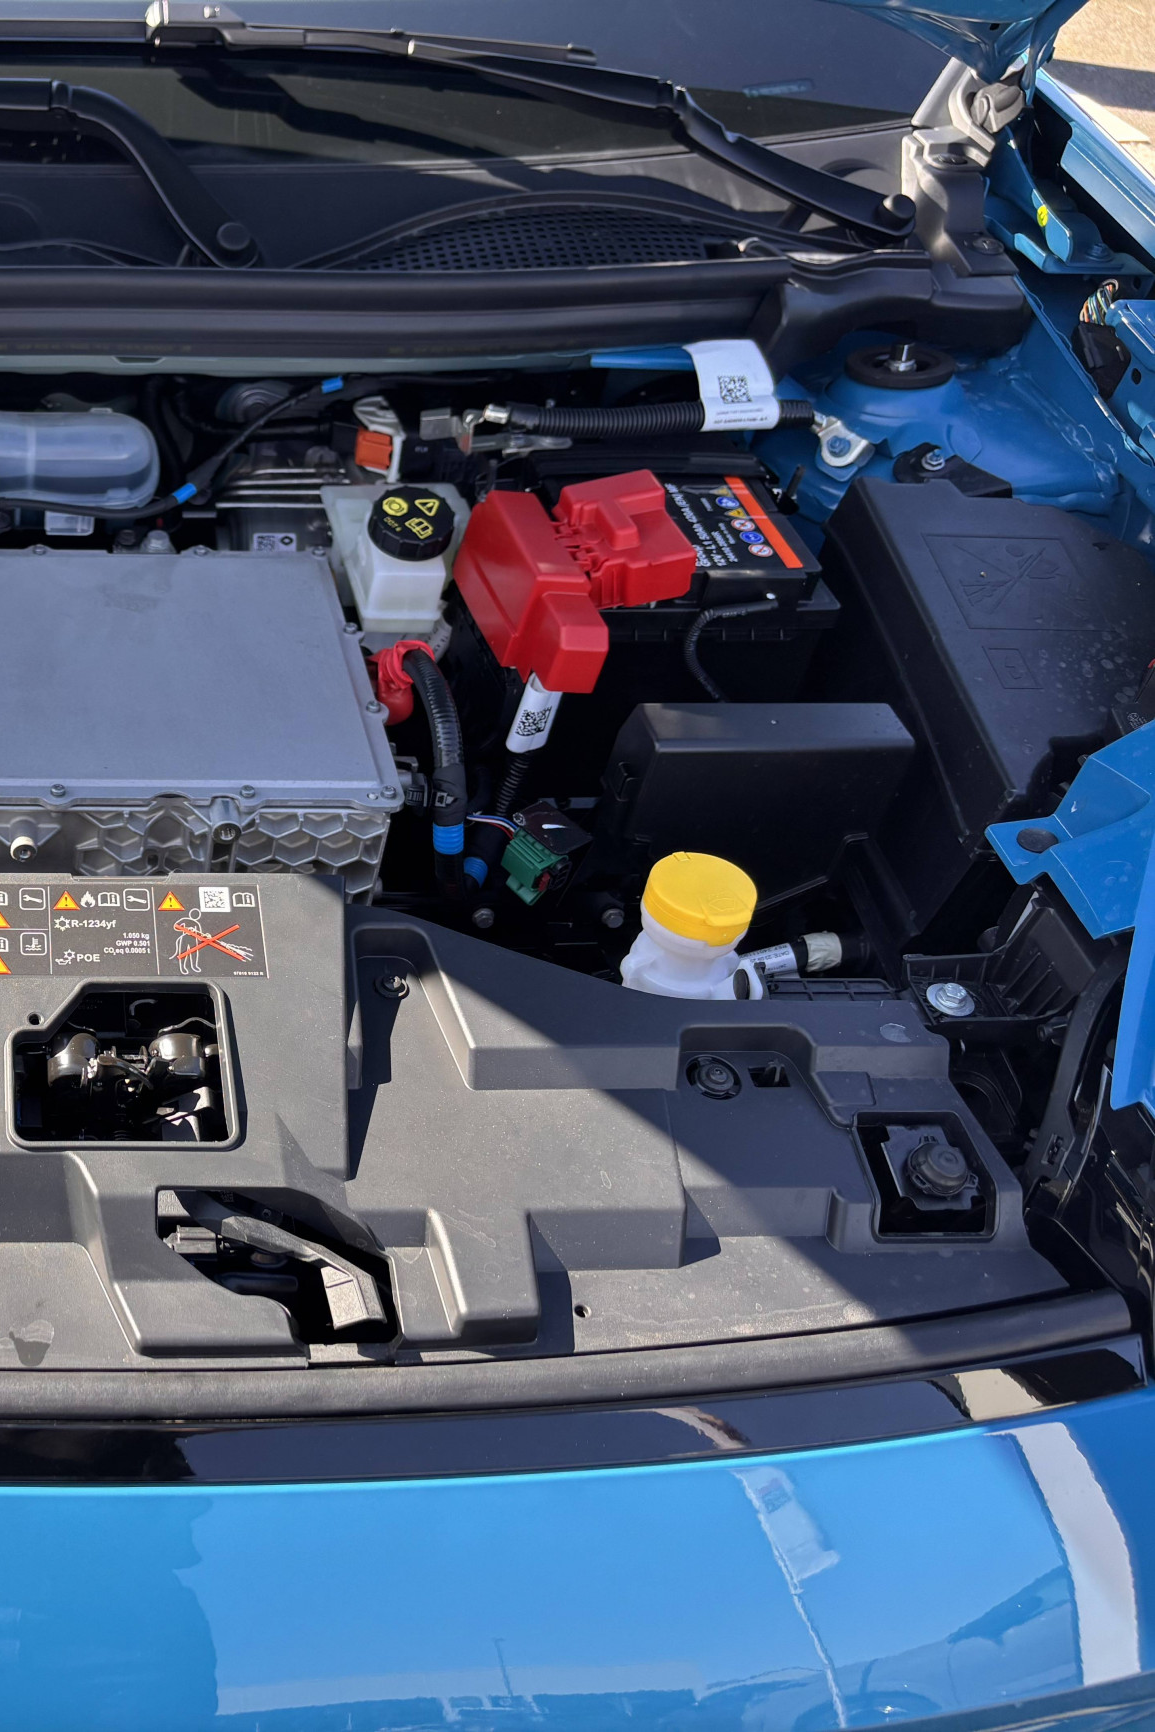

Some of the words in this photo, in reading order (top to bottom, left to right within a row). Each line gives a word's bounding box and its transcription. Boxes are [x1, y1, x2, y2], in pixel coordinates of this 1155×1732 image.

[71, 919, 117, 930] R-1234yf
[141, 932, 150, 940] kg
[76, 953, 101, 962] POE
